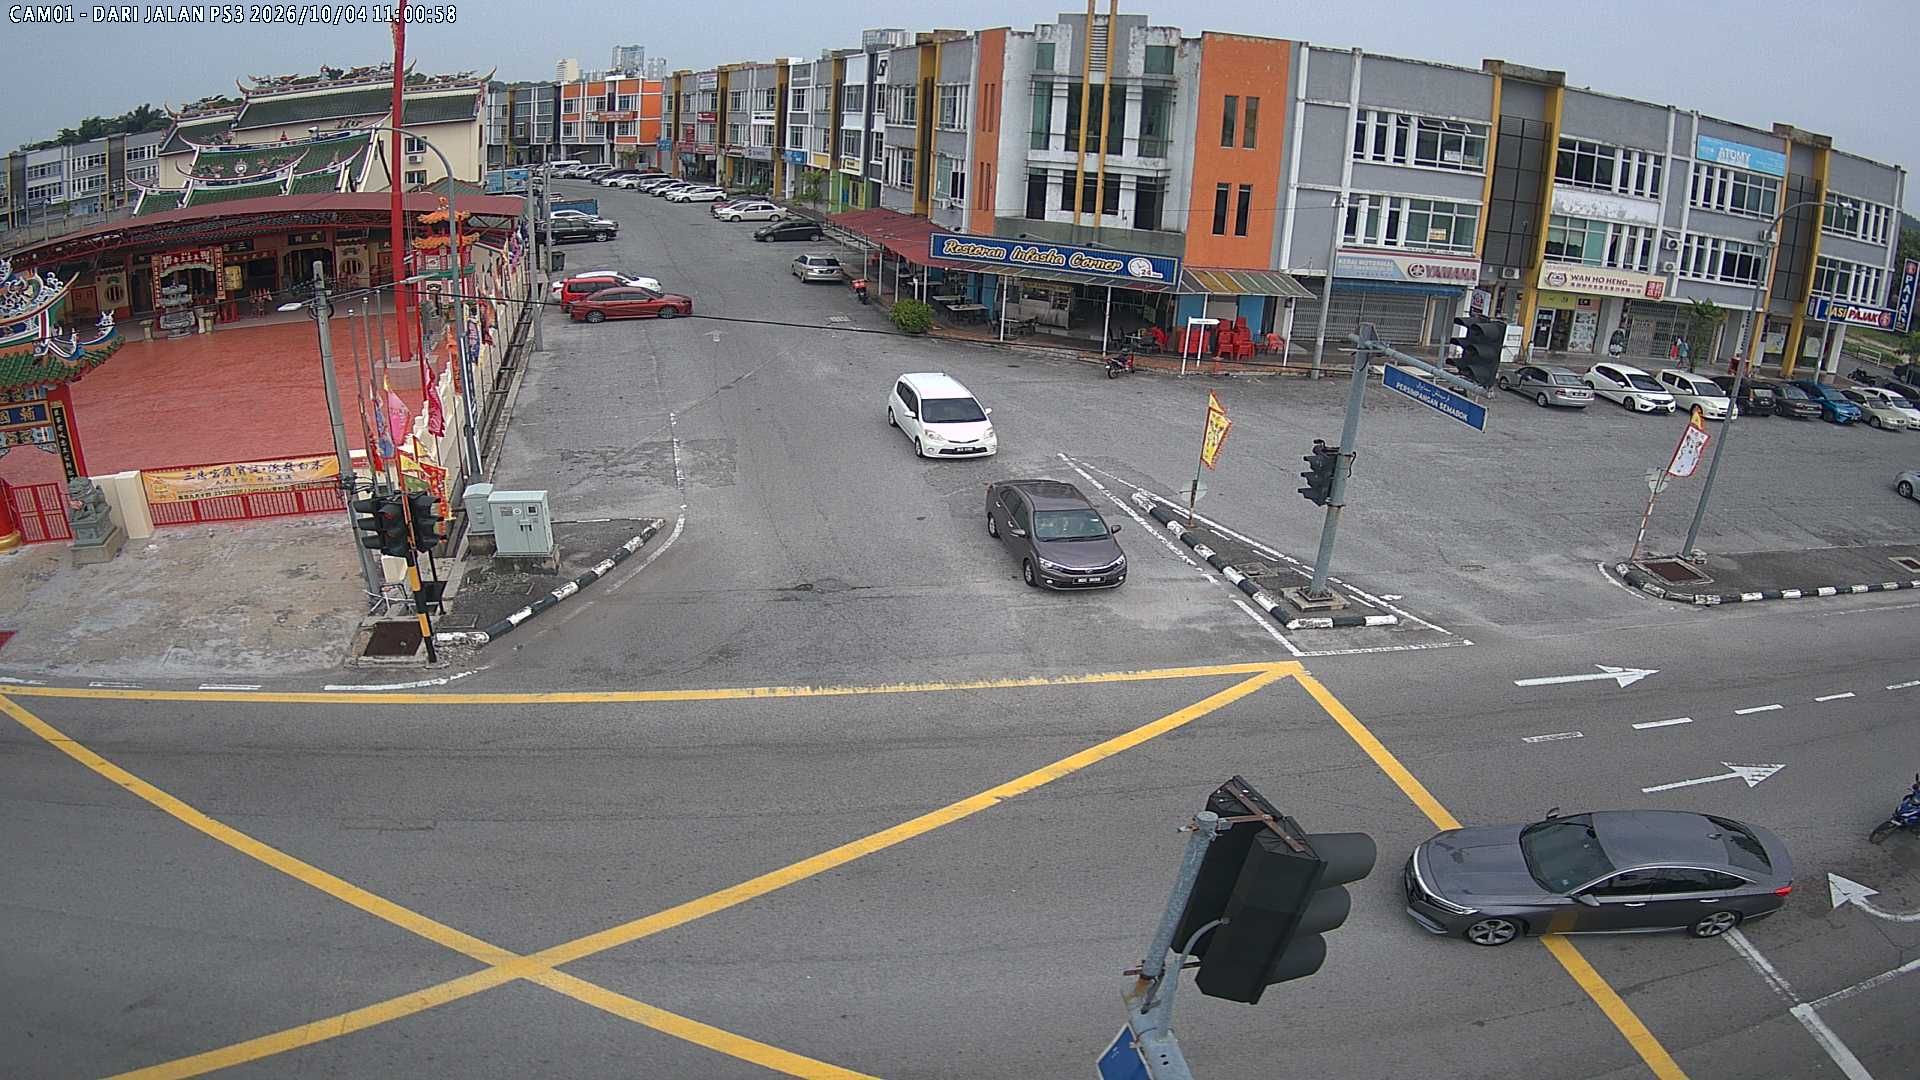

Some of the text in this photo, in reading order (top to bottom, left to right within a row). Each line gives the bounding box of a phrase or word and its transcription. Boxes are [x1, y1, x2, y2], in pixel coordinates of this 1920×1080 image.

[944, 239, 1123, 272] Restoran Infasha Corner
[1426, 264, 1477, 281] YAMAHA
[1570, 274, 1591, 282] WAN
[1592, 276, 1605, 284] HO
[1848, 309, 1879, 323] PAJAK
[1396, 381, 1438, 407] PERSIMPANGAN
[1439, 402, 1469, 421] SEMABOK
